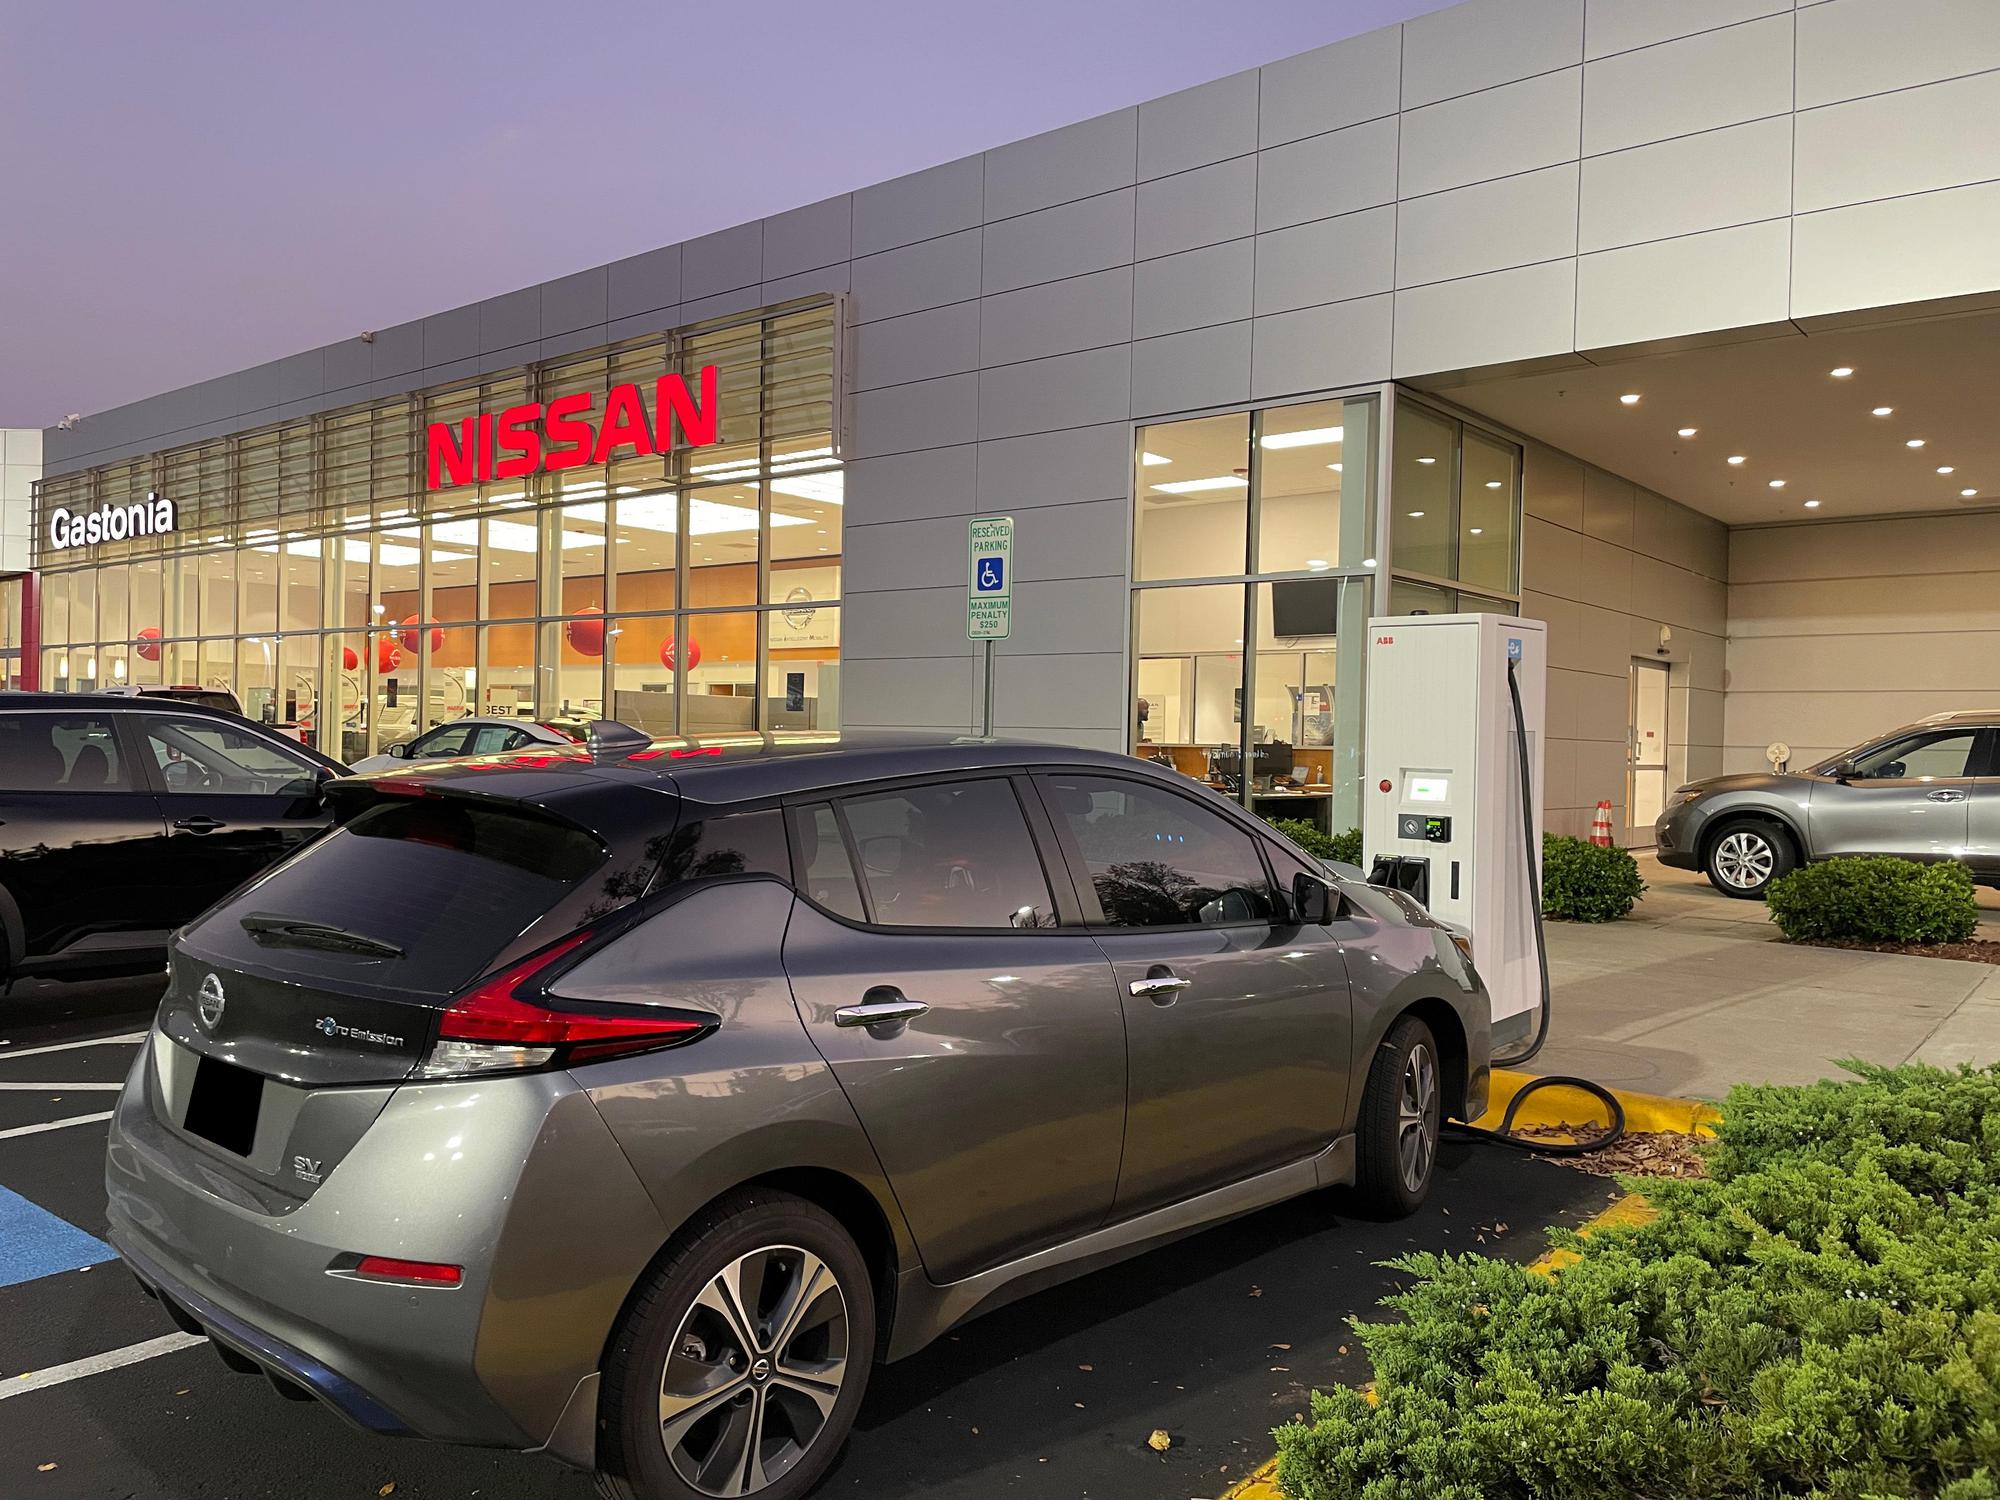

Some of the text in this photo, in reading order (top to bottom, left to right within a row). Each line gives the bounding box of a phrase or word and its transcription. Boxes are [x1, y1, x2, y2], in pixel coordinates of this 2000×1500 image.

[428, 365, 717, 489] NISSAN
[51, 492, 174, 549] Gastonia
[972, 526, 1009, 538] RESERVED
[974, 540, 1008, 552] PARKING
[971, 601, 1008, 610] MAXIMUM
[971, 611, 1007, 619] PENALTY
[980, 620, 998, 629] $250
[1376, 637, 1394, 645] ABB
[350, 1027, 404, 1047] Emission
[294, 1155, 321, 1173] SV
